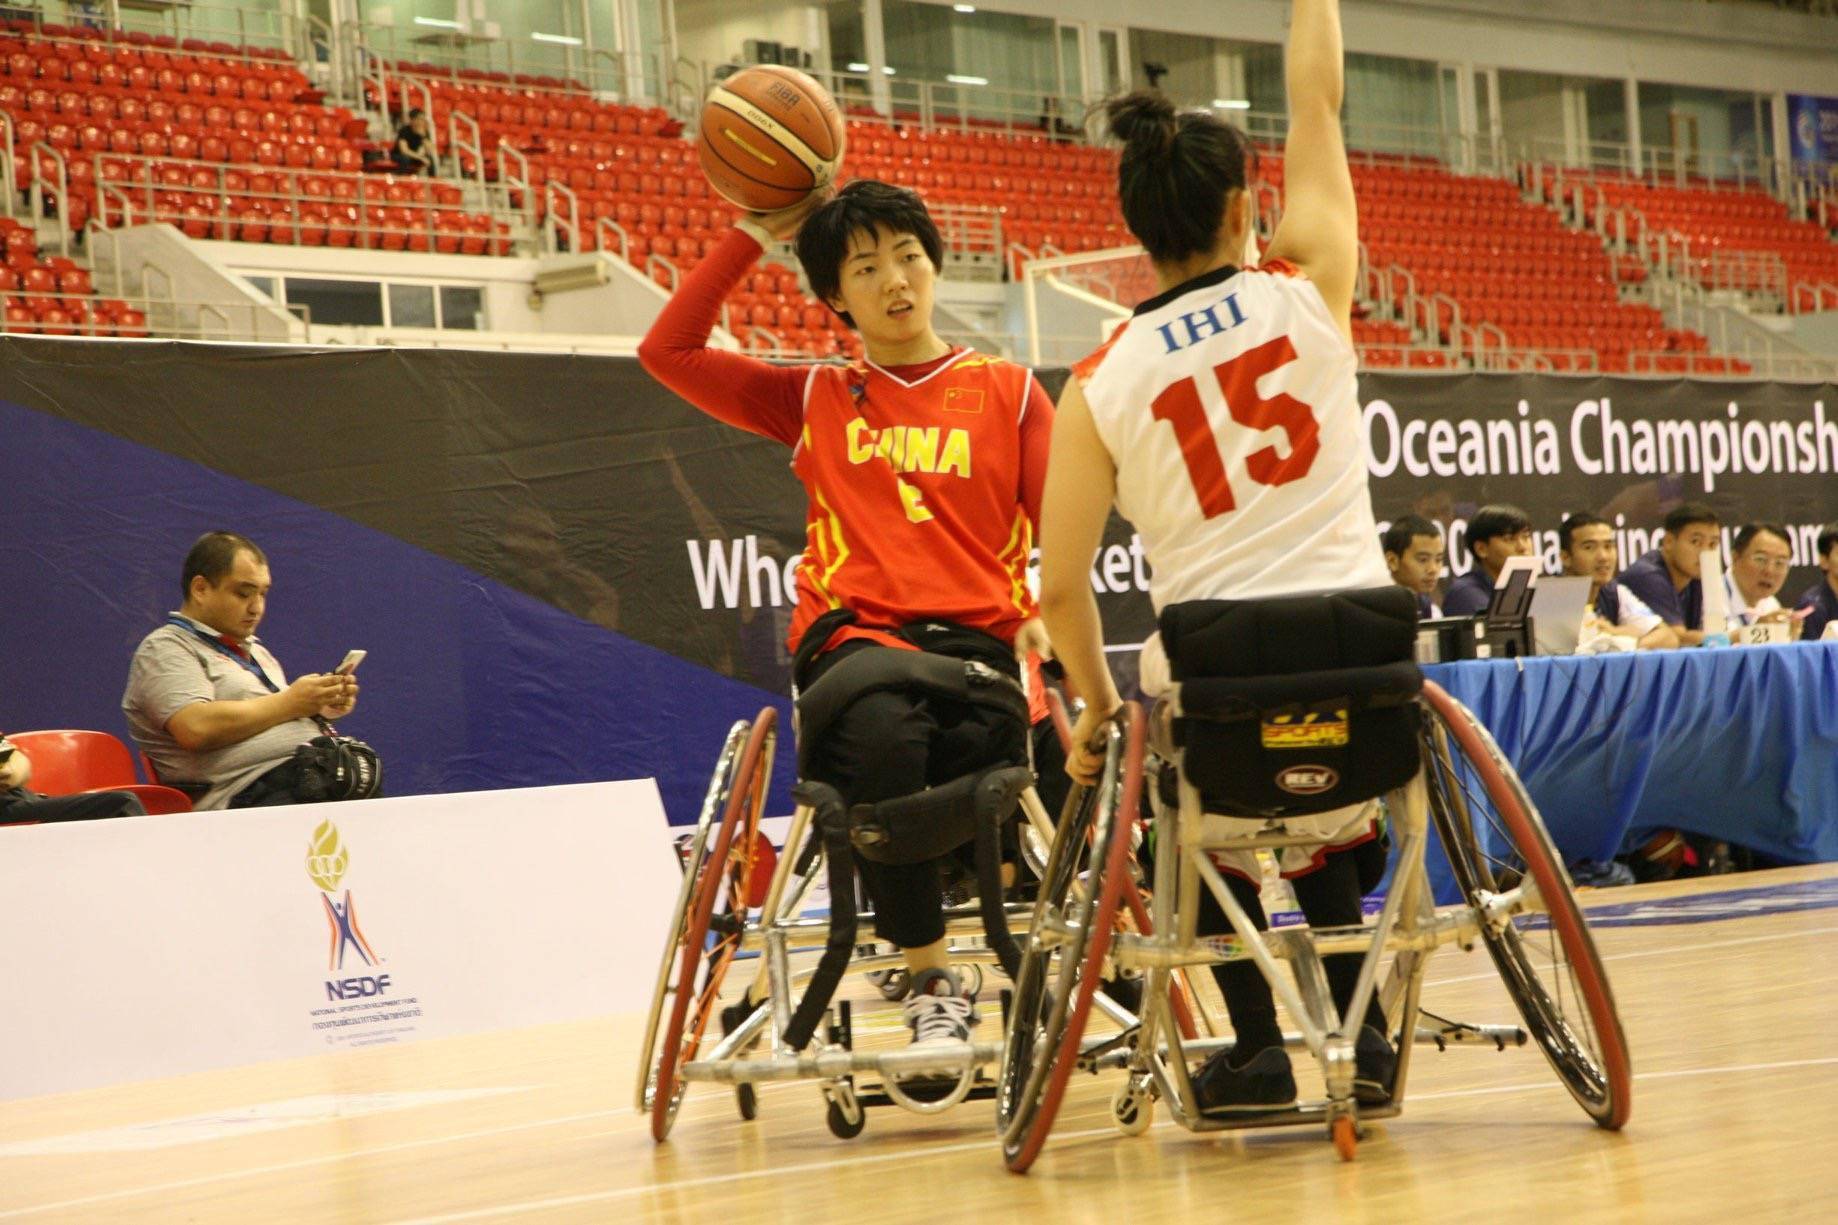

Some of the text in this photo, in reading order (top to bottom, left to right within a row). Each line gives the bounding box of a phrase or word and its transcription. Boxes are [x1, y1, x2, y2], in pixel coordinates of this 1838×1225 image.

[1155, 292, 1248, 354] IHI
[1151, 334, 1321, 520] 15
[1363, 397, 1838, 493] Oceania Championsh
[325, 974, 391, 1001] NSDF
